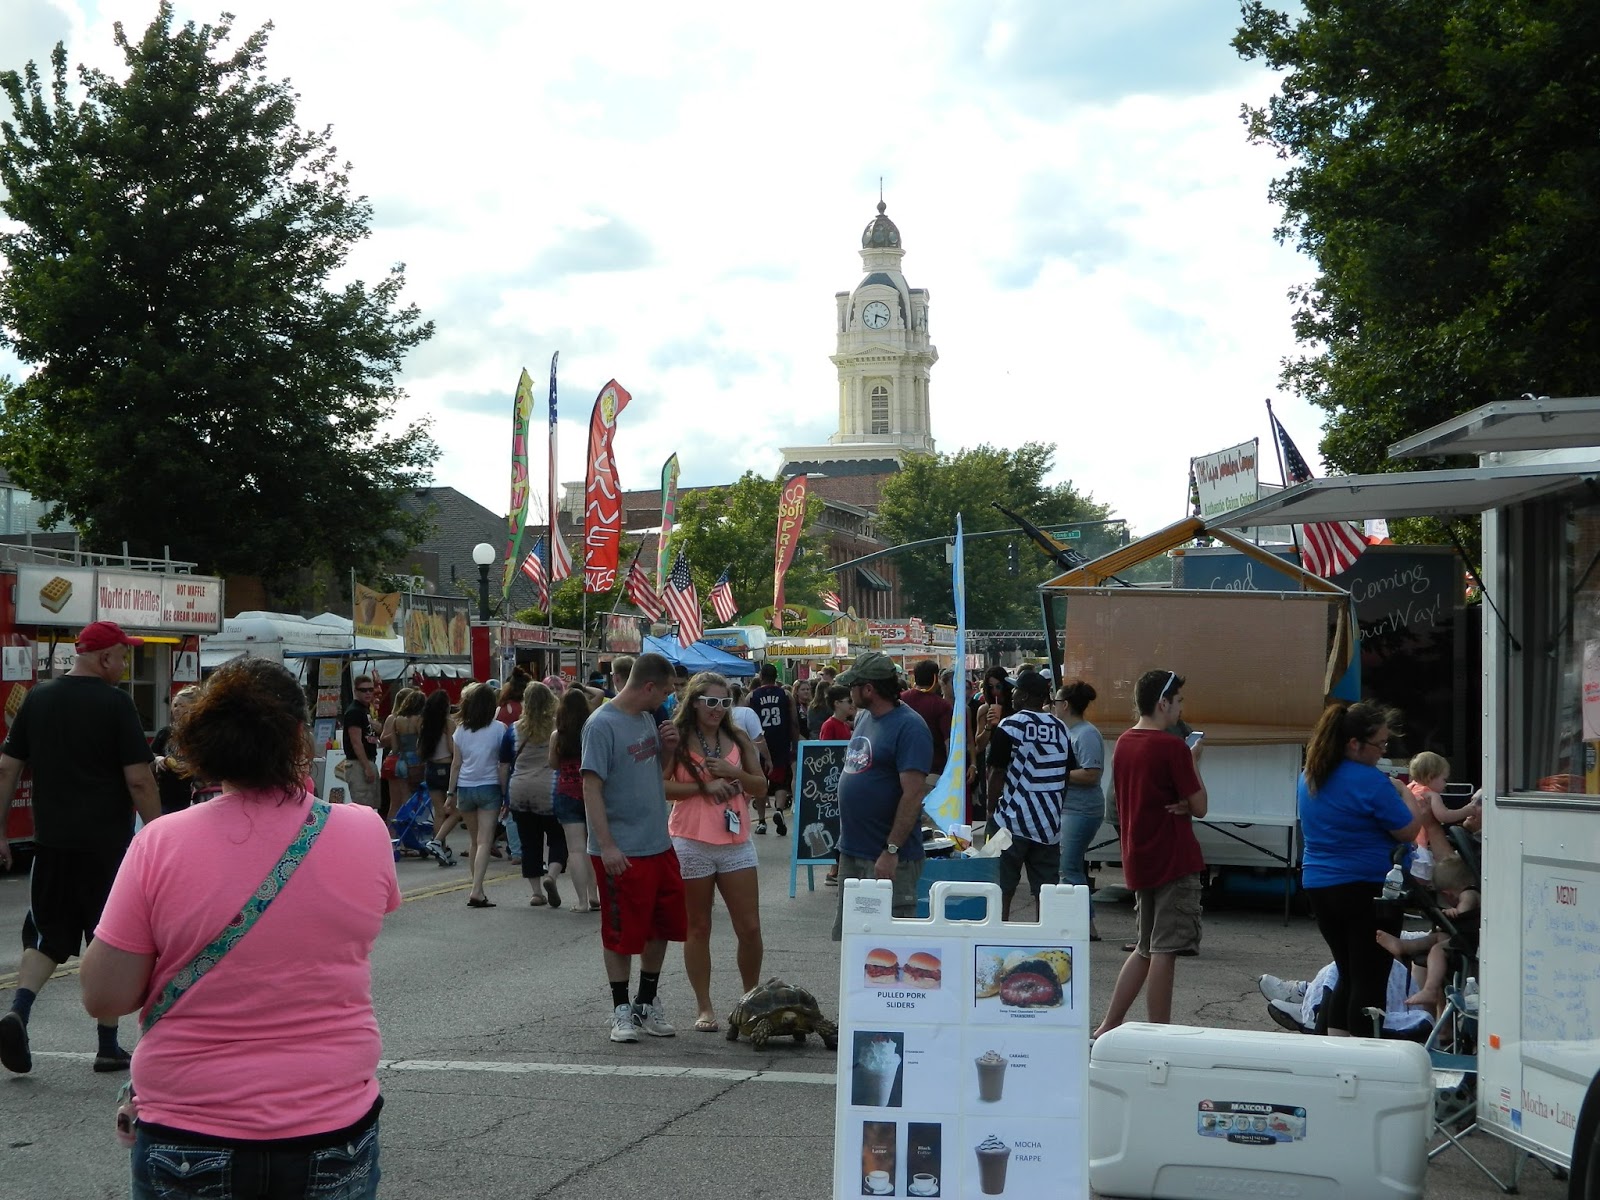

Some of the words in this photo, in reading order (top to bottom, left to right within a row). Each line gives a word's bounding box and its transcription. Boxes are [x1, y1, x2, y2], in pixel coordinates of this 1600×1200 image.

[780, 502, 804, 520] Soft
[176, 584, 186, 597] HOT
[187, 584, 206, 597] WAFFLE
[1350, 563, 1430, 603] Coming
[100, 586, 123, 609] World
[123, 589, 132, 610] of
[132, 590, 160, 611] Waffles
[186, 599, 195, 610] and
[163, 610, 172, 622] ICE
[173, 610, 190, 623] CREAM
[191, 611, 217, 624] SANDWICH
[1358, 620, 1385, 642] our
[1389, 594, 1441, 628] Way!
[759, 695, 780, 706] JAMES
[761, 706, 782, 727] 23
[1024, 722, 1058, 743] 091
[803, 747, 836, 775] Root
[1556, 885, 1578, 906] MENU
[877, 991, 904, 999] PULLED
[906, 991, 926, 999] PORK
[886, 1001, 915, 1009] SLIDERS
[1231, 1103, 1273, 1112] MAXCOLD
[1521, 1089, 1549, 1119] Mocha
[1556, 1102, 1577, 1130] Latte
[1014, 1141, 1042, 1149] MOCHA
[1015, 1154, 1042, 1162] FRAPPE
